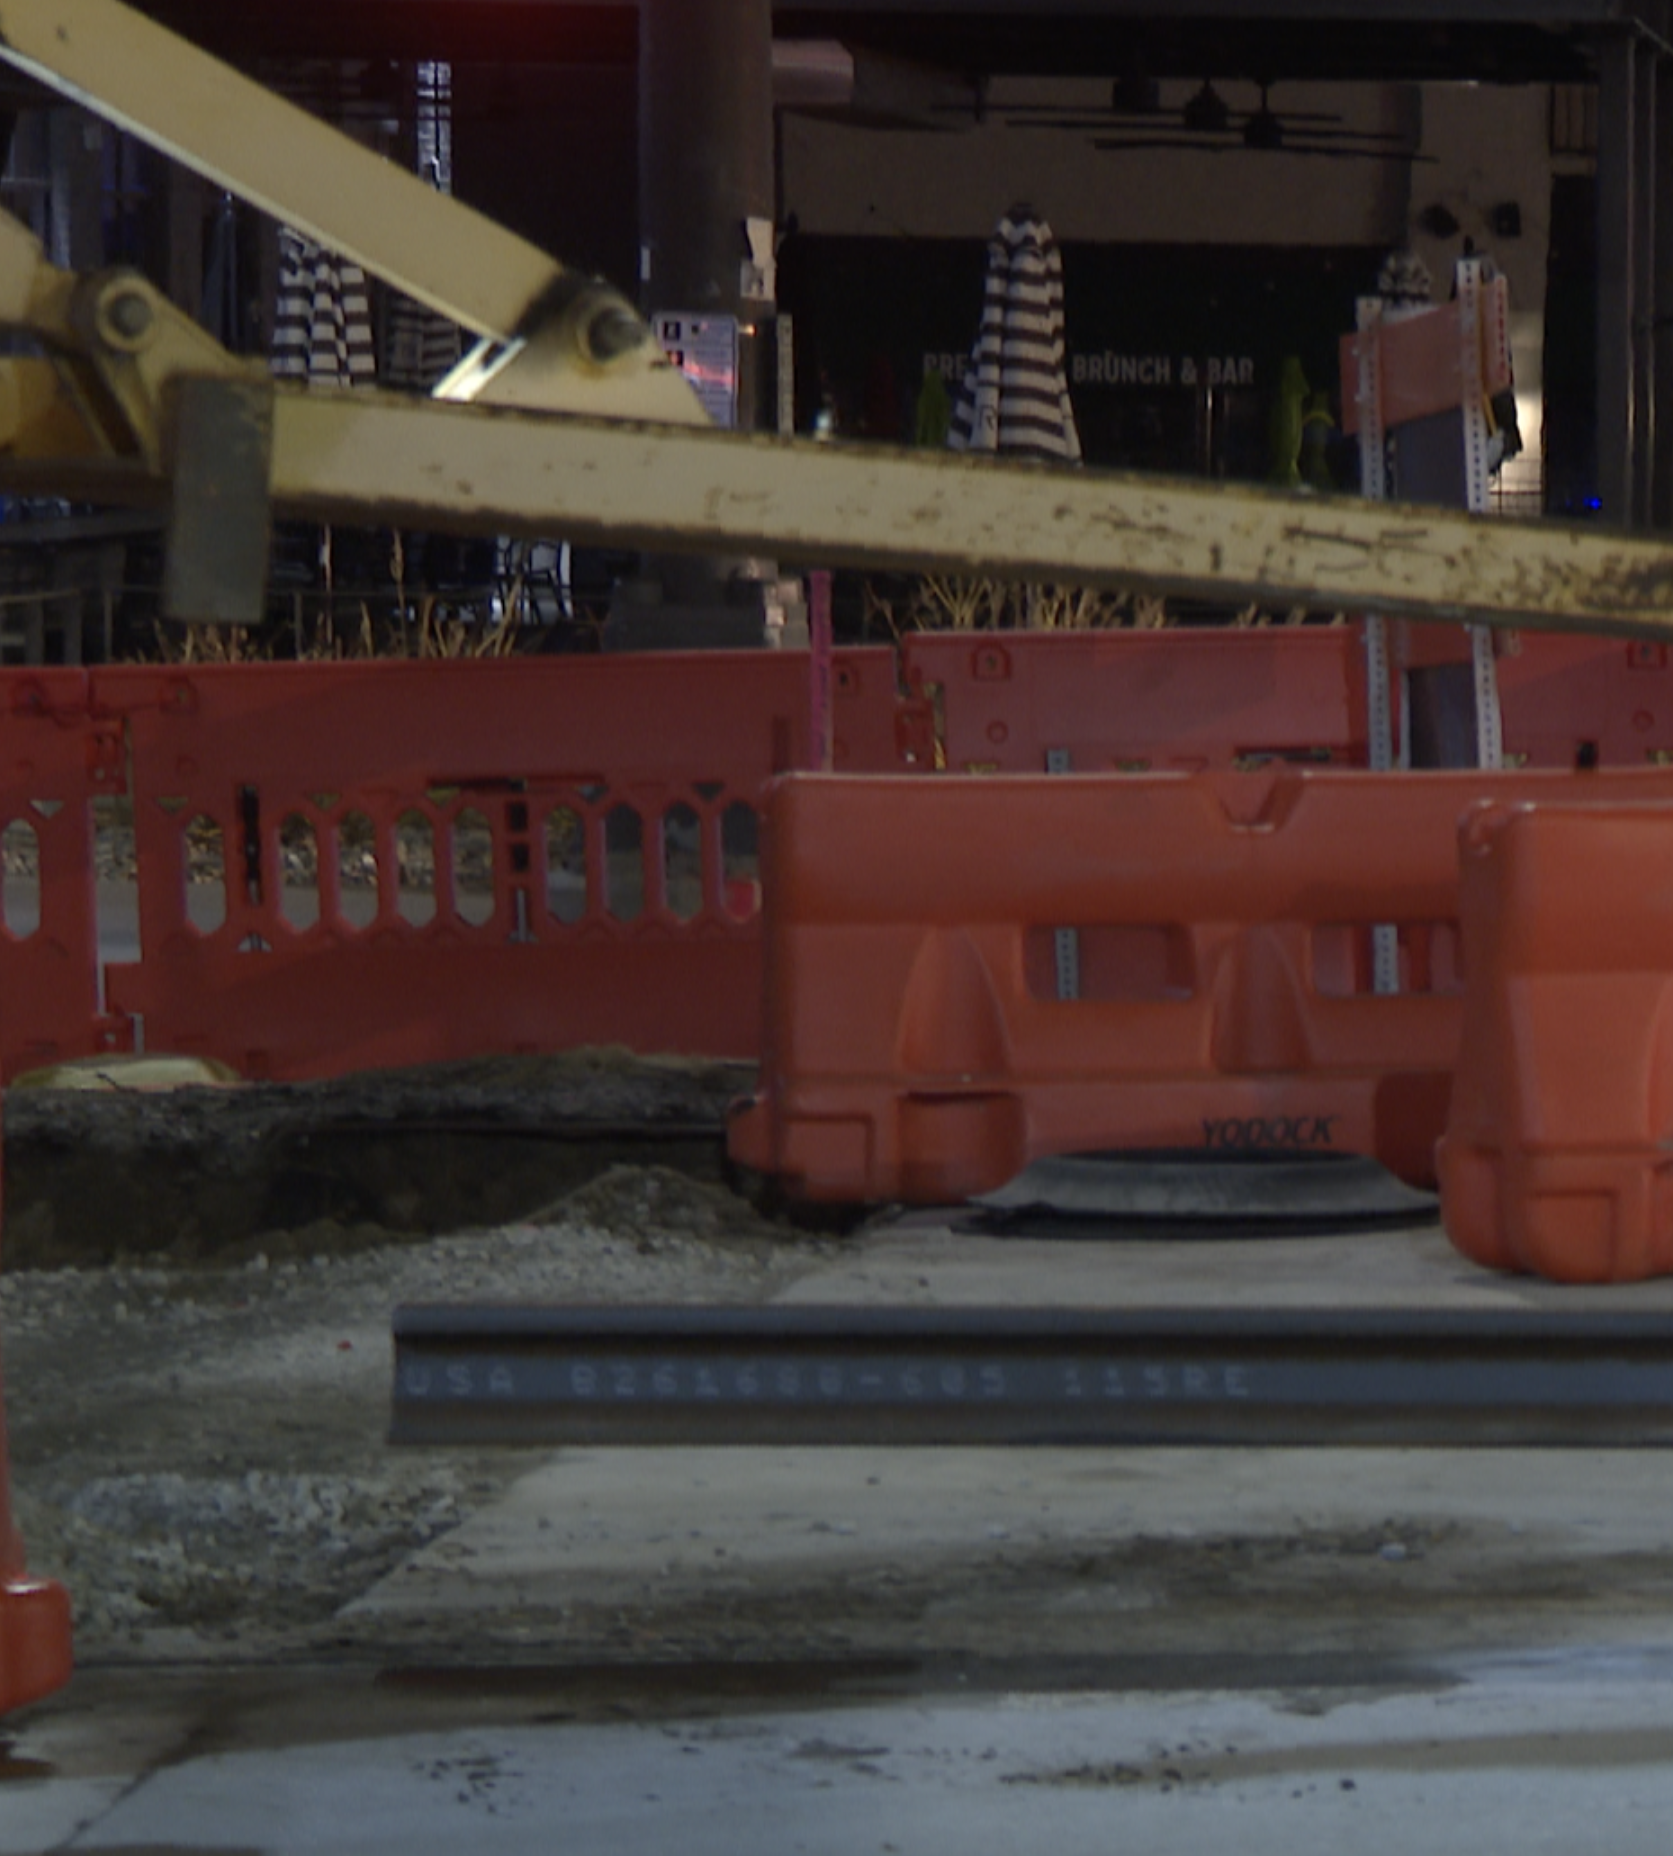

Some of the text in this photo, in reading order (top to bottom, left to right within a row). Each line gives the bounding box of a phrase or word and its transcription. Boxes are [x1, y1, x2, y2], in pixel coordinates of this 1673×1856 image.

[1180, 355, 1198, 386] &
[1206, 356, 1255, 386] BAR
[1202, 1115, 1336, 1146] YODOCK
[403, 1362, 514, 1398] USA
